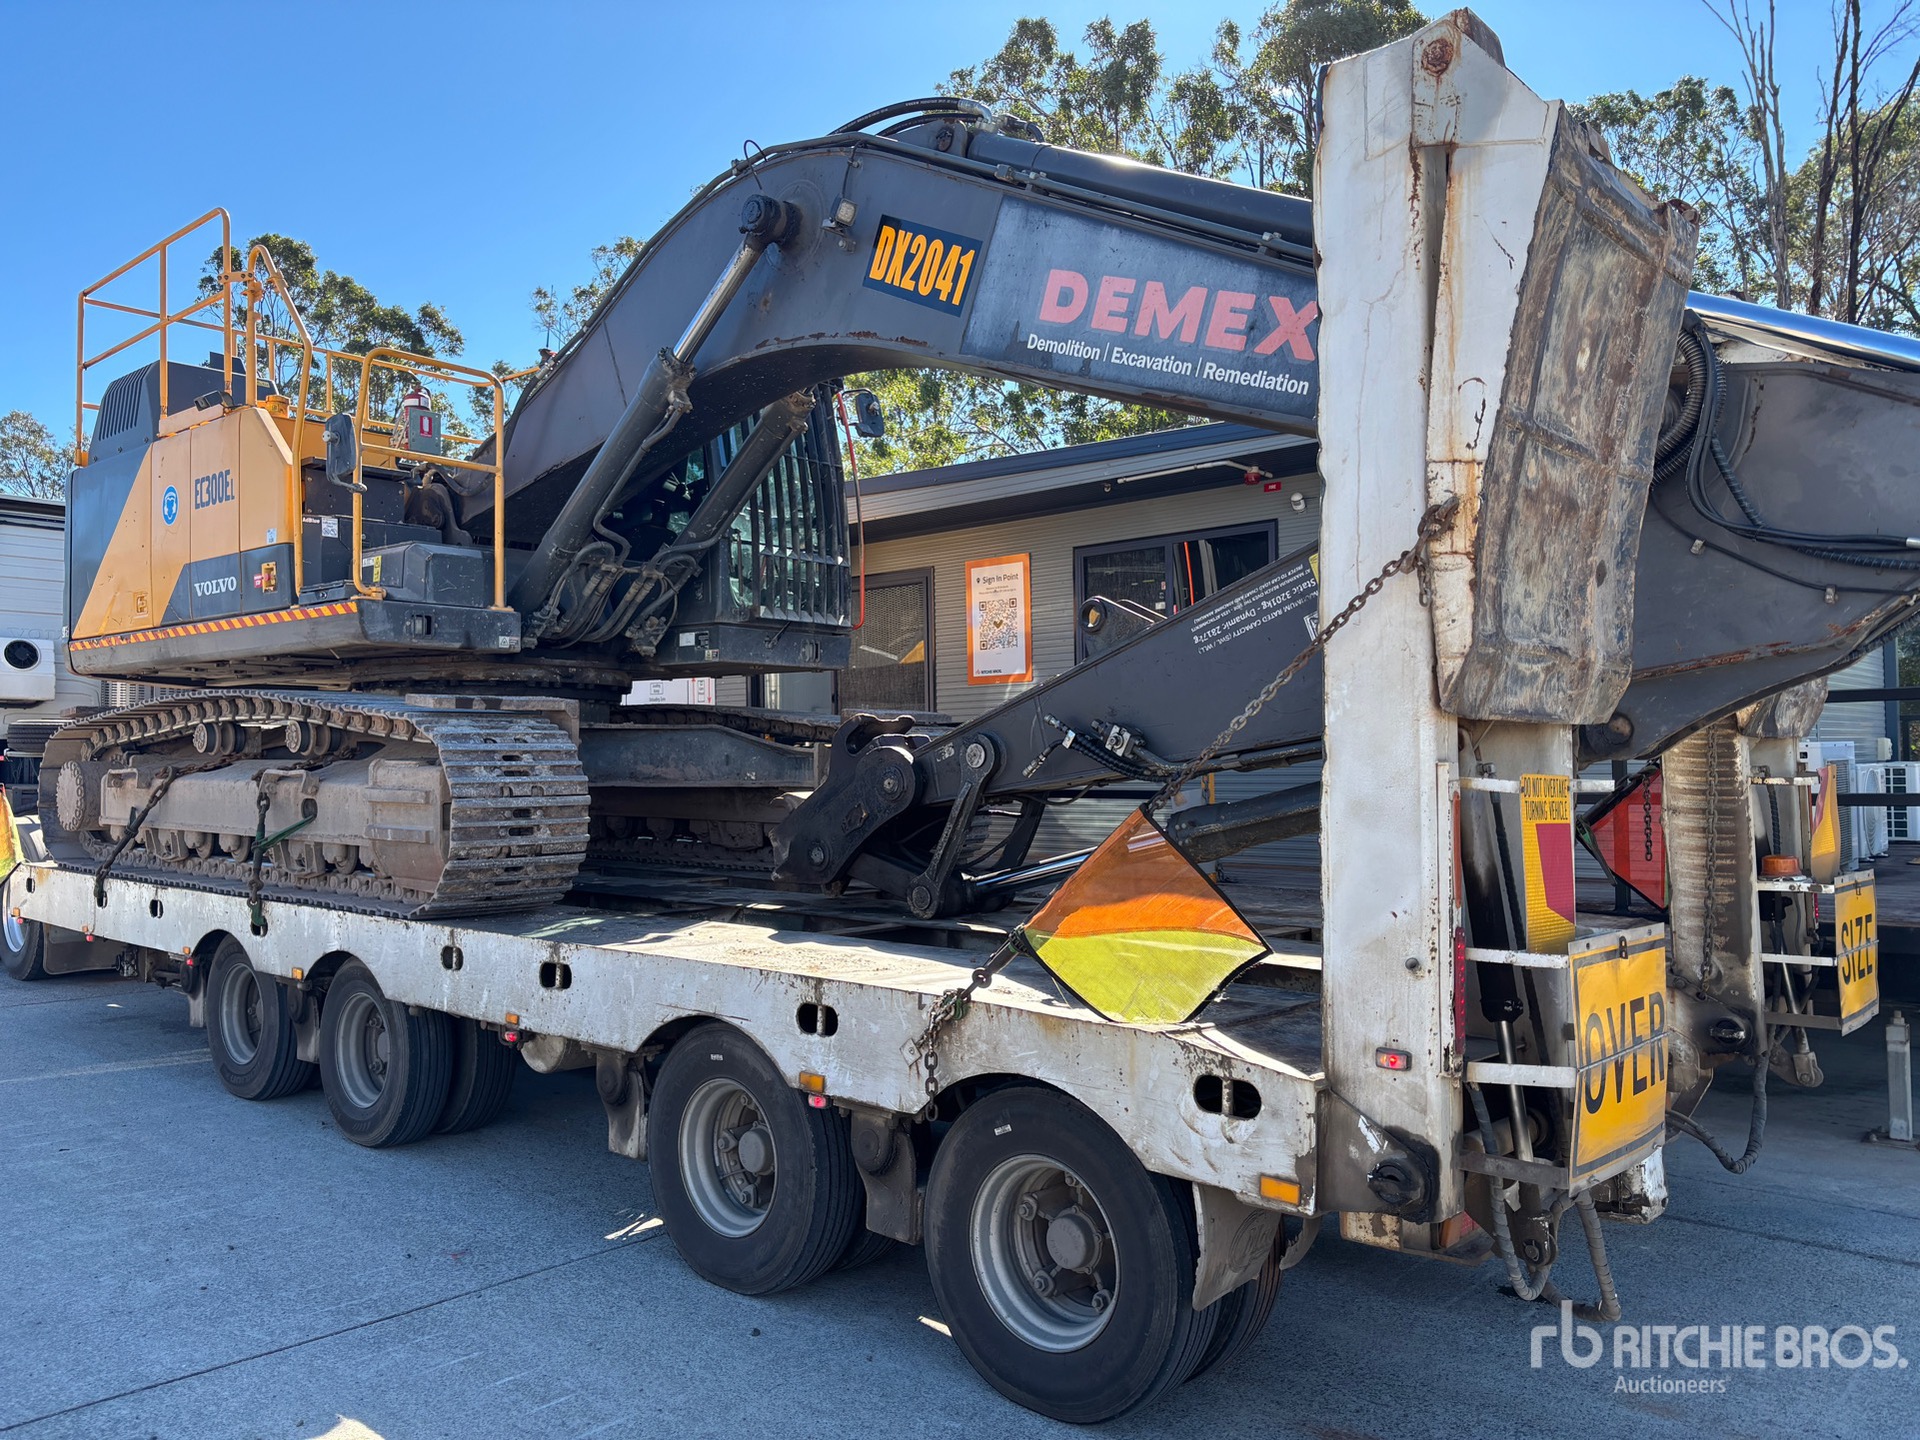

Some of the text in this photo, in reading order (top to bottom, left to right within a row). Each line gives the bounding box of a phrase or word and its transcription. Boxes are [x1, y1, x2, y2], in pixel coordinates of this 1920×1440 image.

[869, 225, 976, 306] DX2041
[1039, 268, 1318, 361] DEMEX
[1027, 334, 1101, 361] Demolition
[1111, 347, 1192, 376] Excavation
[1203, 362, 1310, 396] Remediation
[194, 576, 237, 597] VOLVO
[982, 576, 996, 585] Sign
[1003, 573, 1019, 581] Point
[1291, 576, 1316, 595] Static
[1260, 588, 1291, 611] 3201kg
[1221, 606, 1256, 631] Dynamic
[1261, 607, 1282, 622] RATED
[1192, 624, 1221, 645] 2817kg
[1231, 617, 1261, 638] CAPACITY
[1524, 776, 1568, 798] DO NOT OVERTAKE
[1525, 800, 1568, 821] TURNING VEHICLE
[1841, 913, 1873, 985] SIZE
[1585, 991, 1665, 1114] OVER
